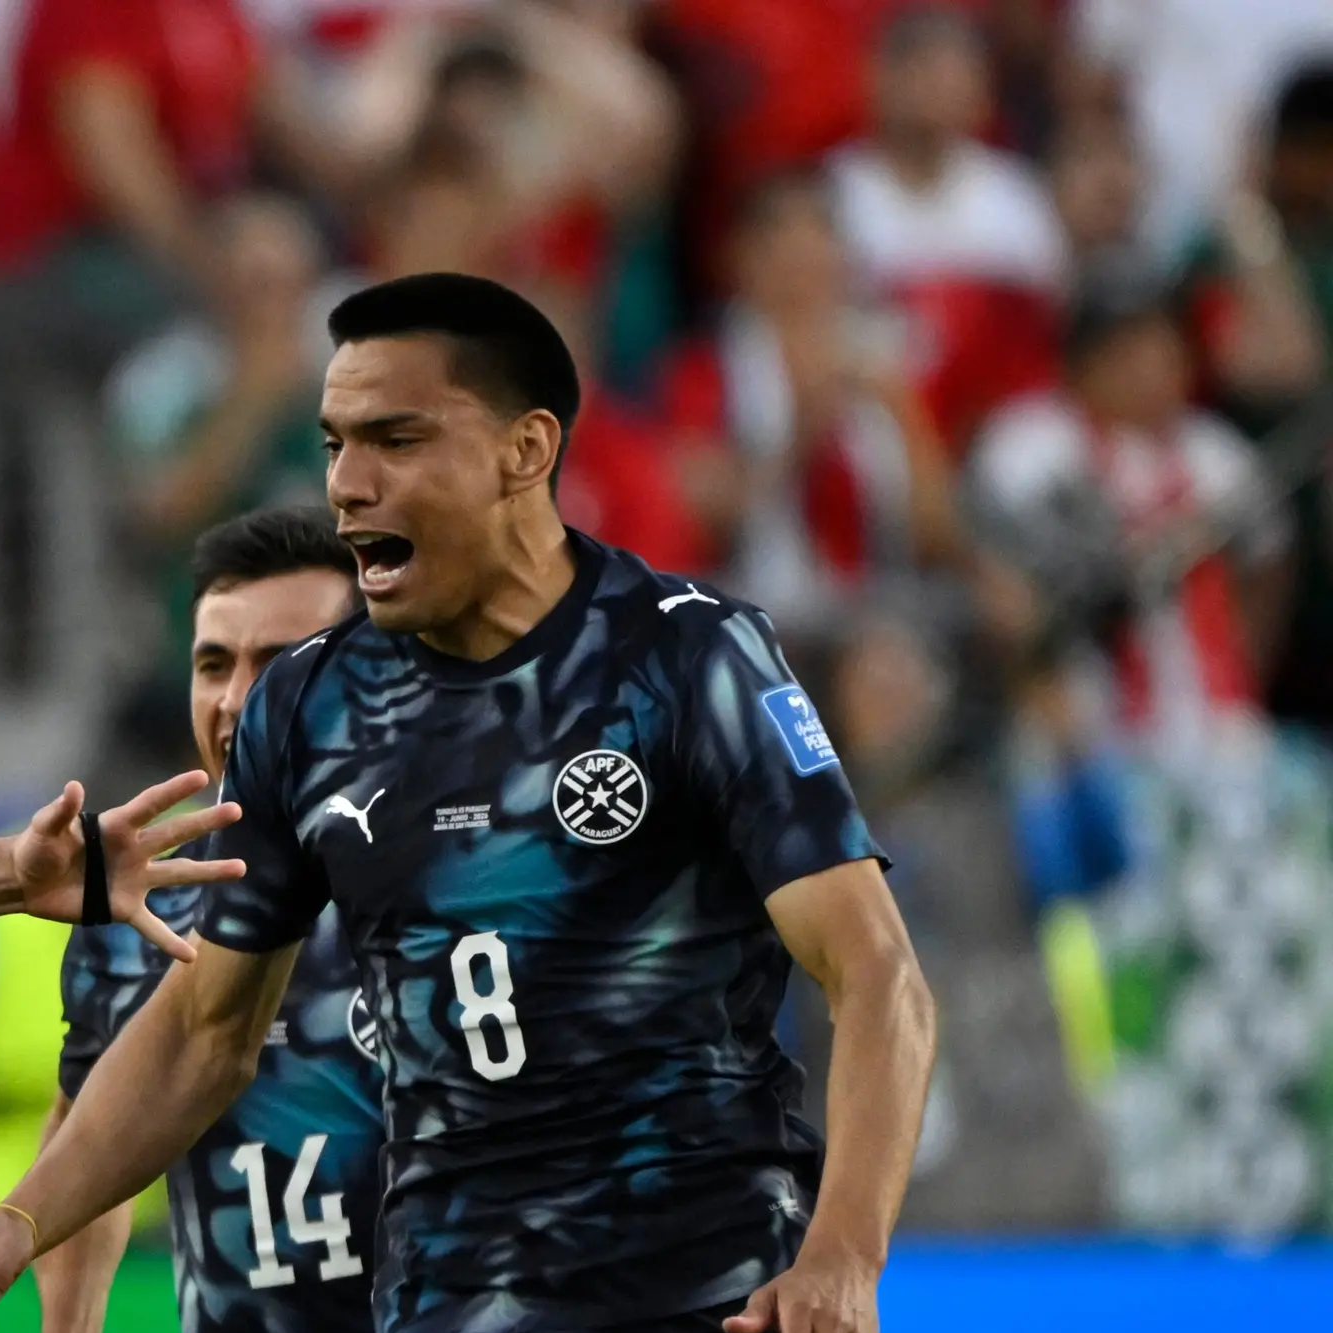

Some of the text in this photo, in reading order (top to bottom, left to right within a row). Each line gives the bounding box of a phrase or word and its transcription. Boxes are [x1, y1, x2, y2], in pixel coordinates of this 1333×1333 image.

[584, 757, 616, 773] APF
[579, 825, 623, 838] PARAGUAY
[449, 930, 527, 1082] 8
[230, 1134, 363, 1290] 14
